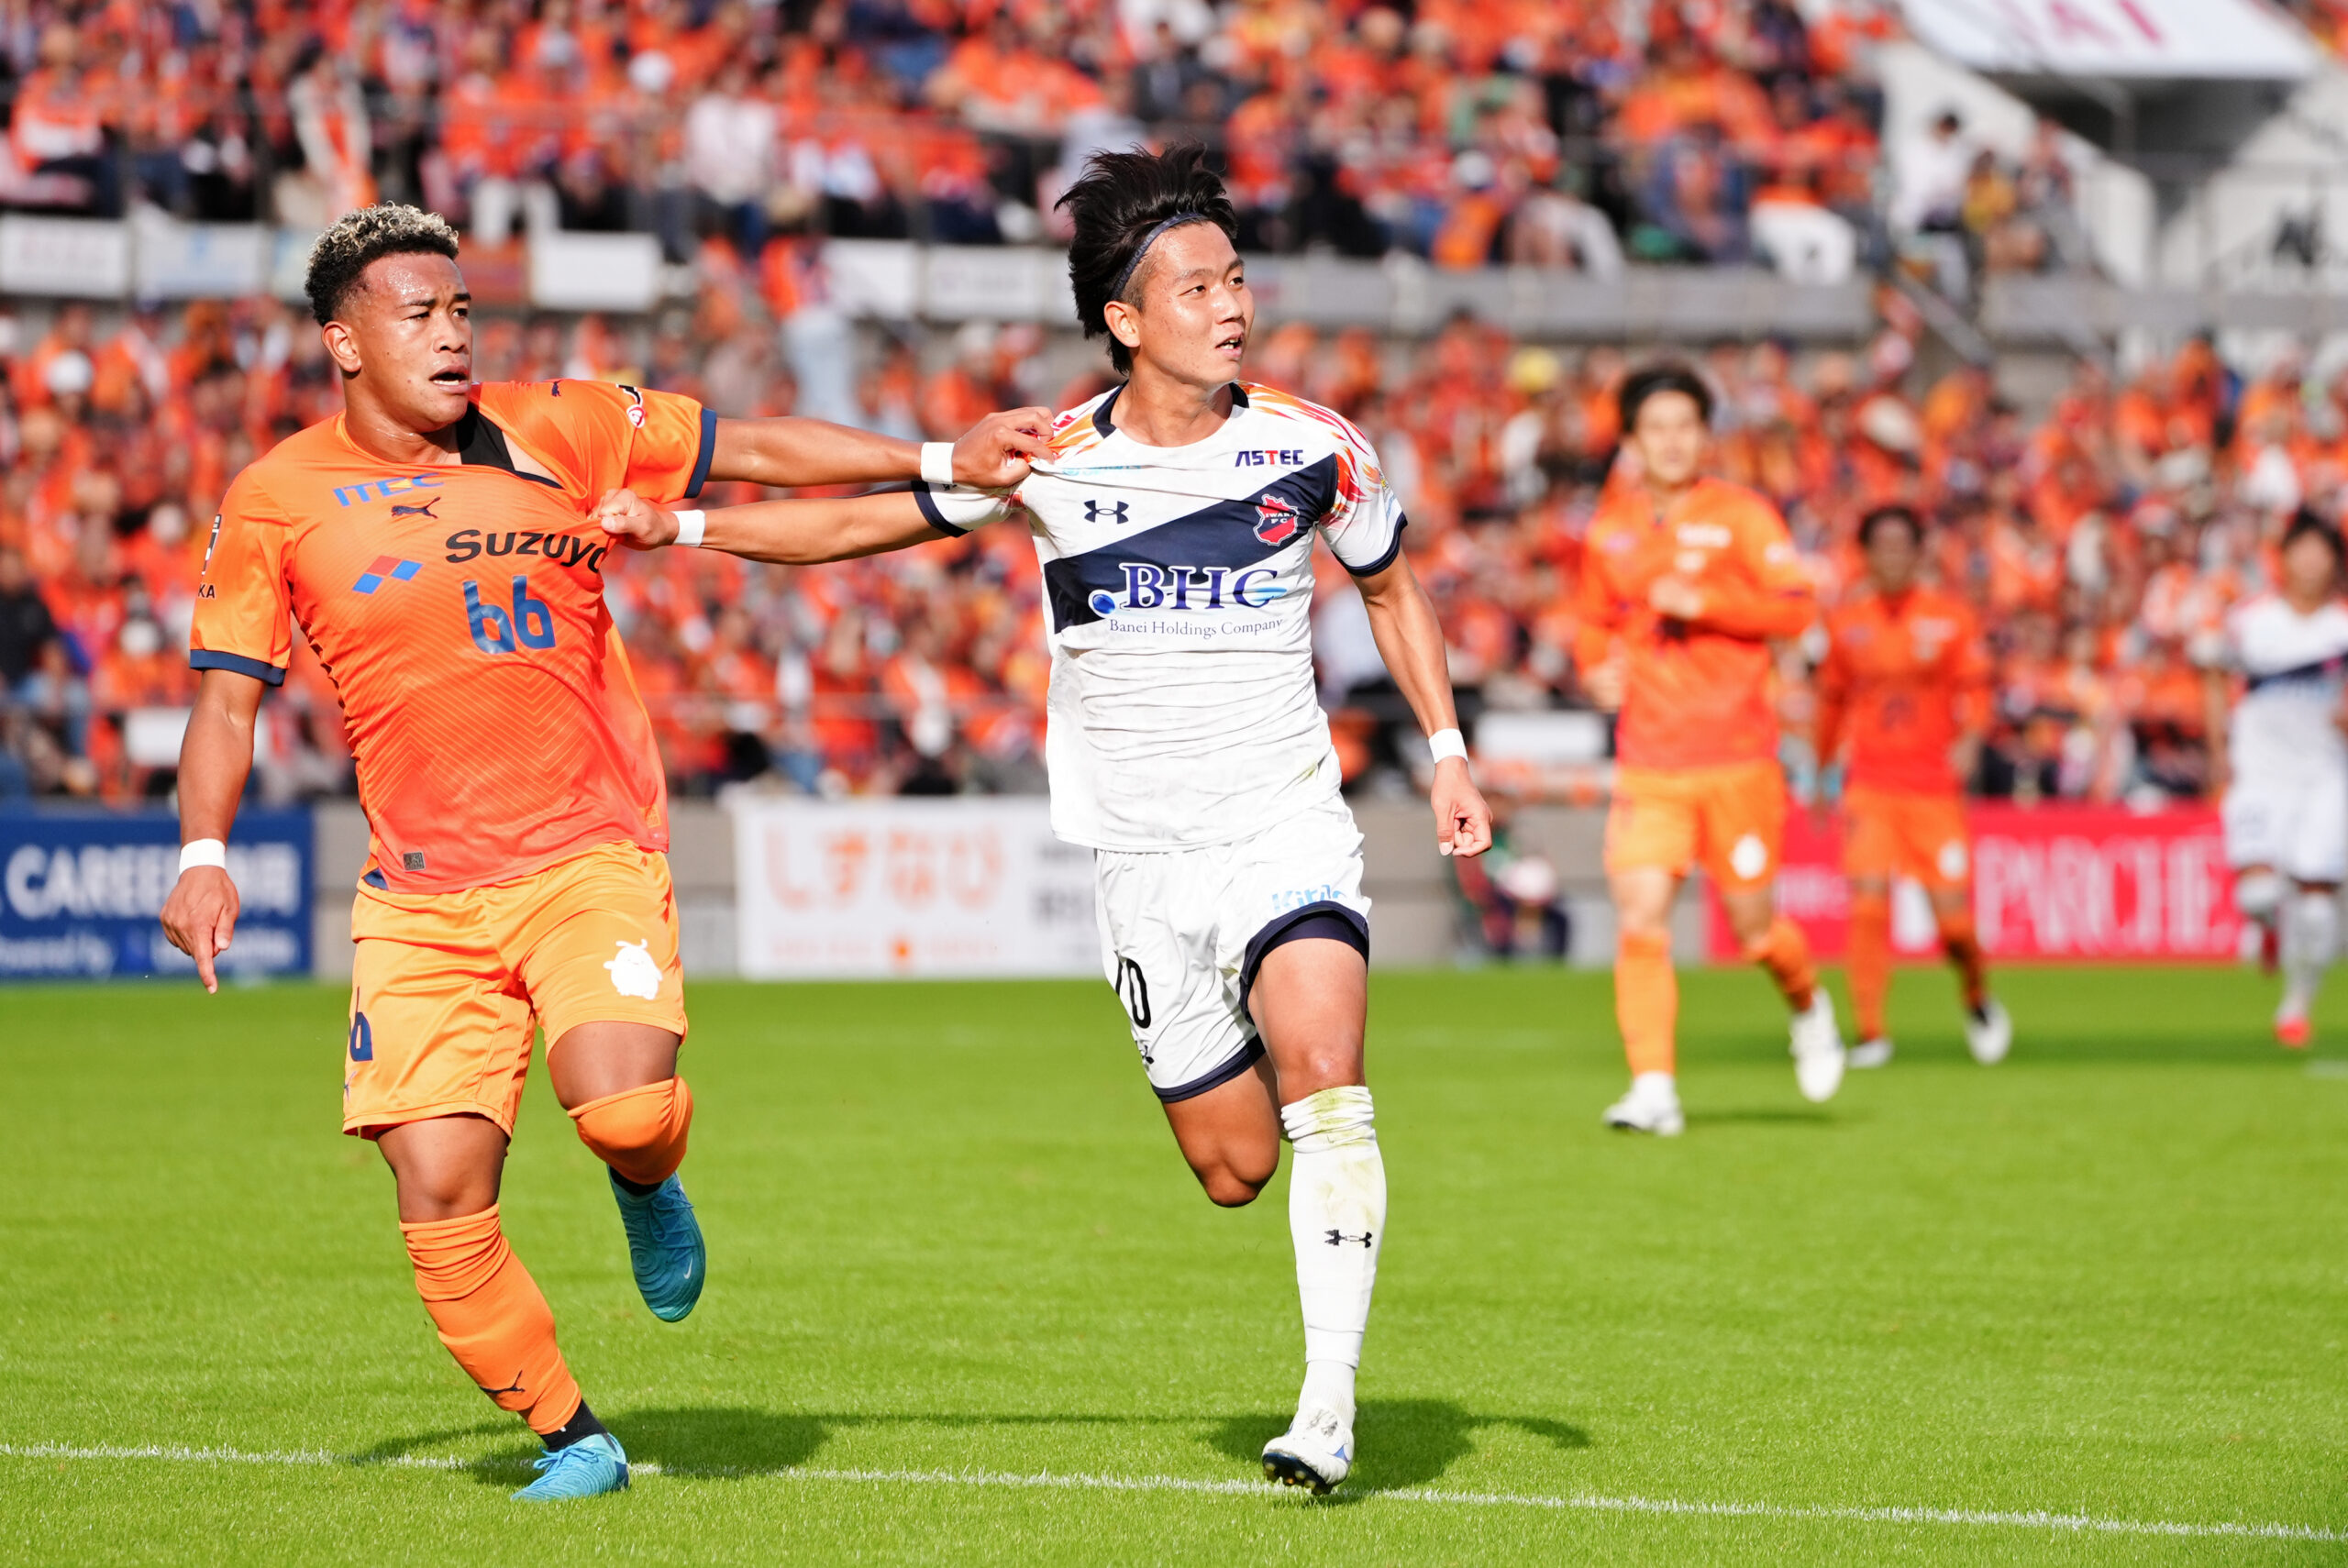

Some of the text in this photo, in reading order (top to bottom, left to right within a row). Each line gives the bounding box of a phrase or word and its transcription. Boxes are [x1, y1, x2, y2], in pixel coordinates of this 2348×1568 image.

[1235, 449, 1304, 467] ASTEC
[332, 472, 445, 507] ITEC
[1119, 564, 1279, 609] BHC
[462, 575, 556, 655] 66
[1109, 617, 1284, 639] Banei Holdings Company
